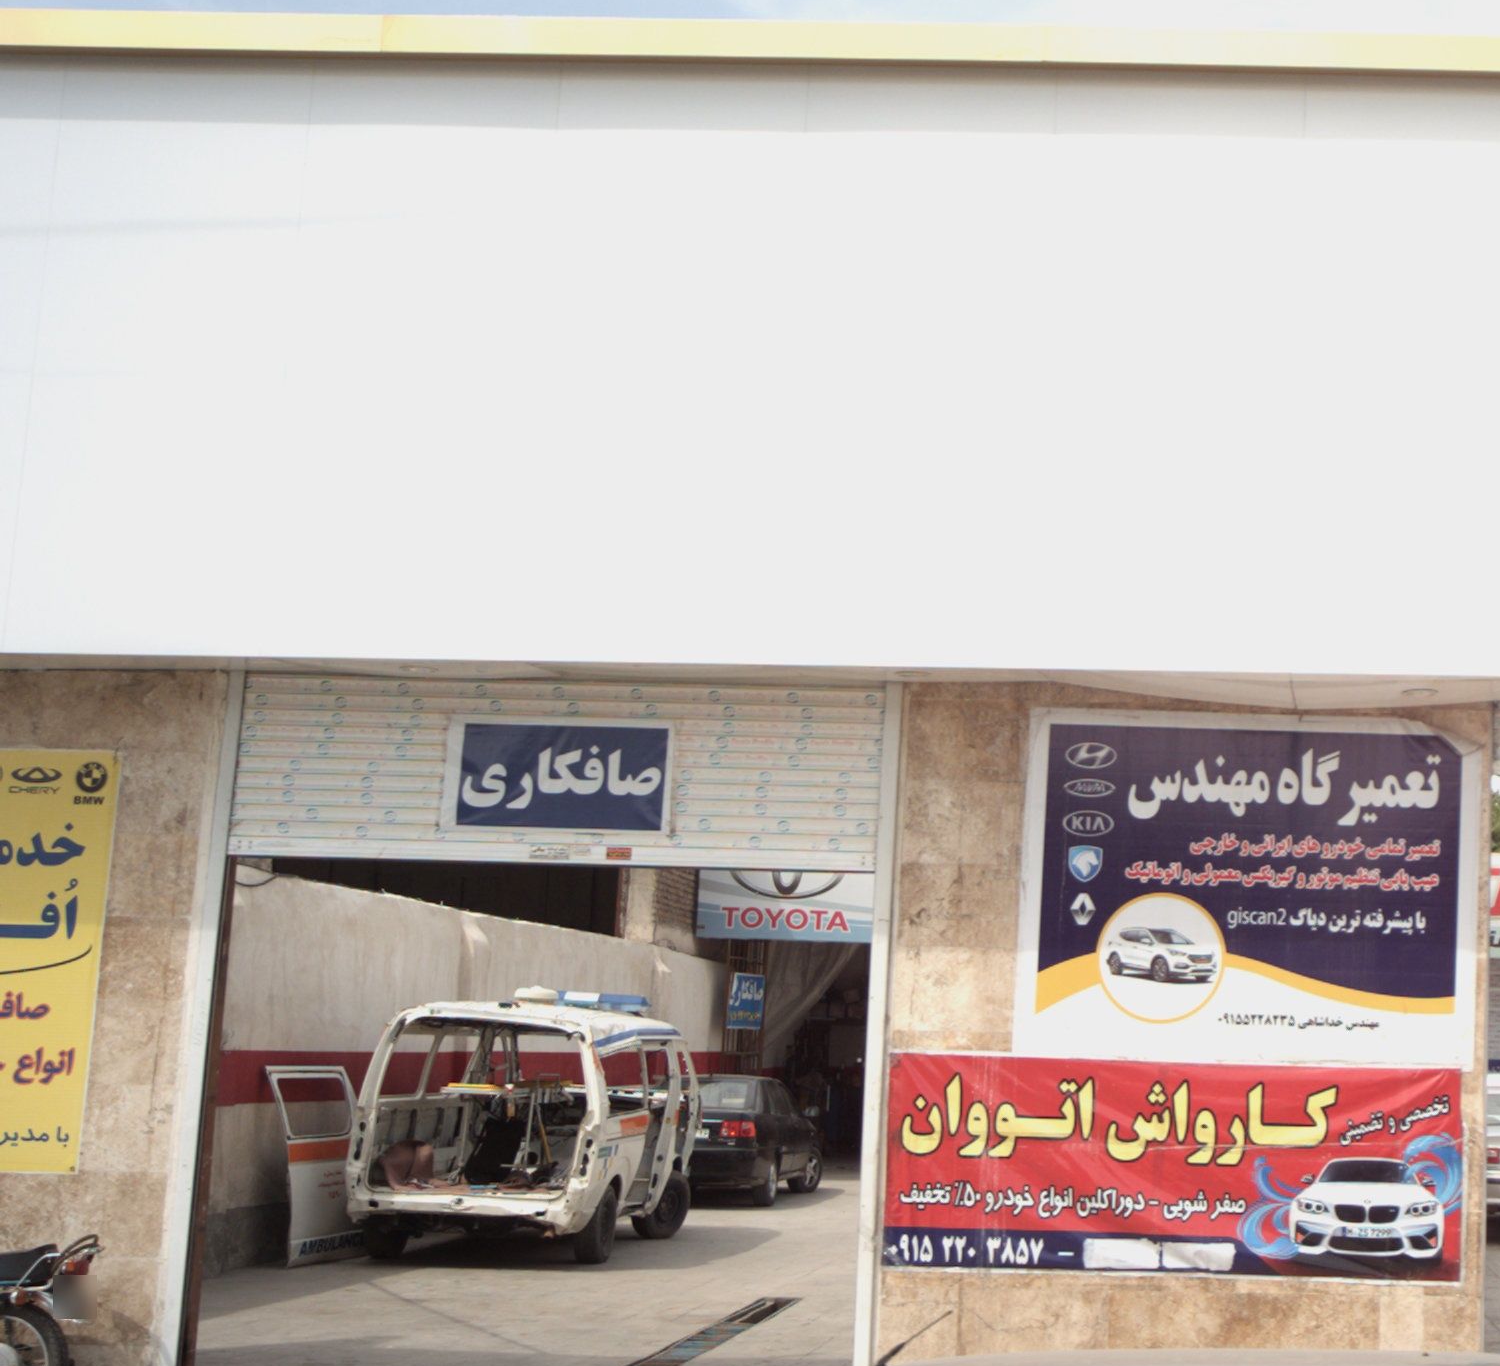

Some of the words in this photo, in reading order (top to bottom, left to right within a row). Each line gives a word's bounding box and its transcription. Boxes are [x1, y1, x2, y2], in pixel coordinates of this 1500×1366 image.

[462, 745, 662, 809] صافکاری
[1127, 755, 1271, 820] مهندس
[1277, 748, 1341, 806] گاه
[9, 786, 60, 795] CHERY
[73, 795, 104, 805] BMW
[1337, 754, 1441, 826] تعمیر
[1072, 816, 1105, 831] KIA
[1189, 833, 1239, 855] خارجی
[1239, 840, 1250, 857] و
[1251, 834, 1293, 857] ایرانی
[1365, 837, 1406, 860] تمامی
[1405, 839, 1442, 861] تعمیر
[1180, 868, 1192, 885] و
[1192, 863, 1242, 886] معمولی
[1295, 872, 1306, 889] و
[1306, 867, 1343, 890] موتور
[1343, 866, 1381, 890] تنظیم
[722, 907, 850, 933] TOYOTA
[1227, 907, 1287, 929] giscan2
[1328, 910, 1361, 934] ترین
[1415, 910, 1426, 934] با
[13, 1047, 76, 1085] انواع
[901, 1072, 1094, 1158] اتووان
[1106, 1079, 1339, 1166] کارواش
[56, 1126, 70, 1148] با
[900, 1182, 952, 1211] تخفیف
[984, 1185, 1036, 1216] خودرو
[1037, 1184, 1074, 1218] انواع
[1162, 1189, 1209, 1221] شویی
[1209, 1193, 1247, 1220] صفر
[889, 1234, 934, 1262] ۰۹۱۵
[986, 1237, 1045, 1265] ۳۸۵۷
